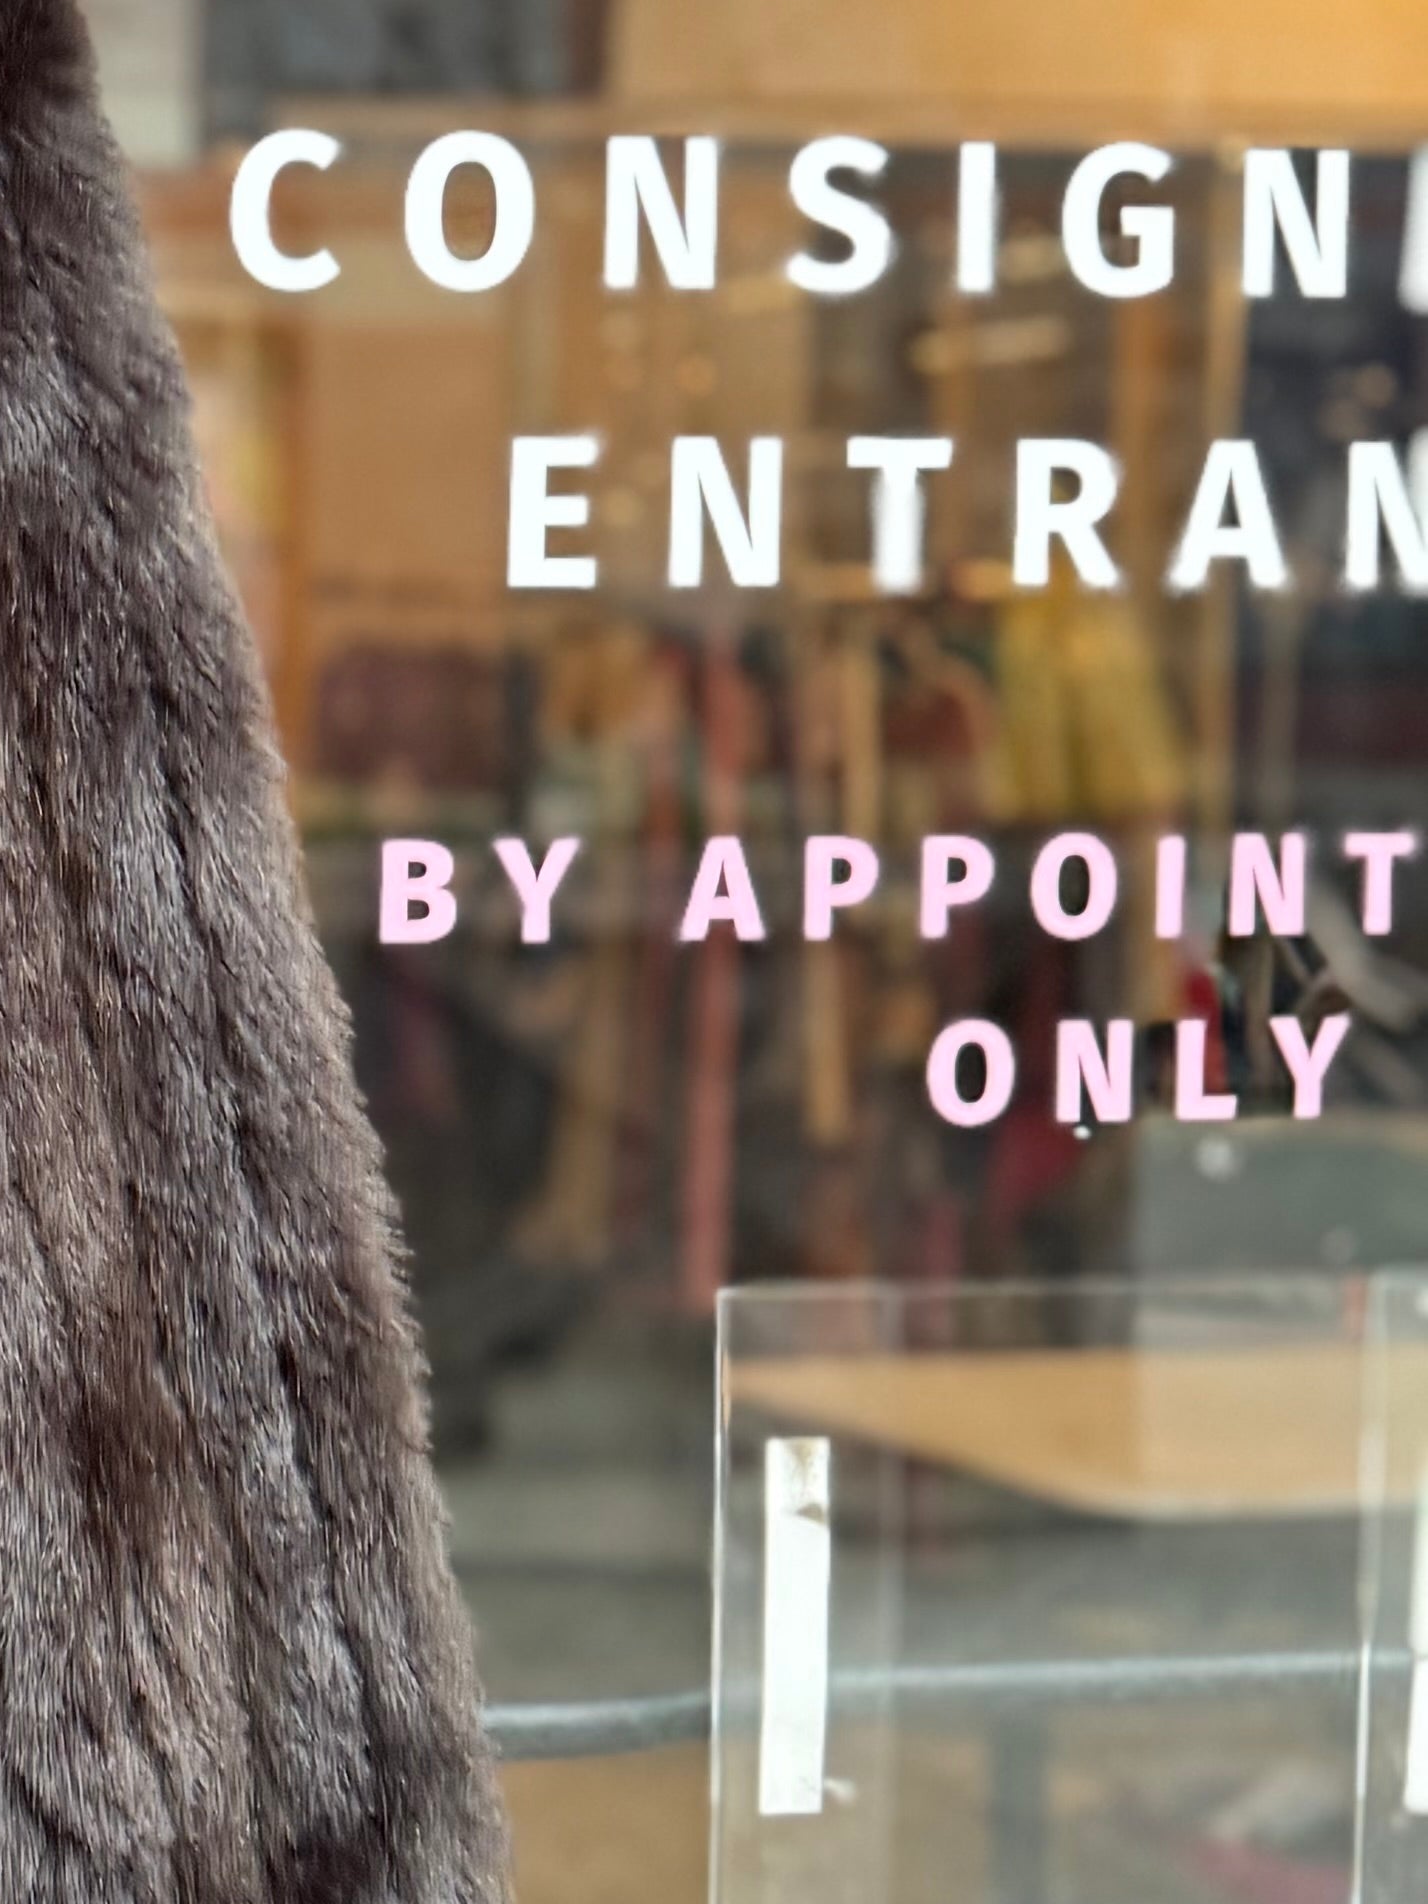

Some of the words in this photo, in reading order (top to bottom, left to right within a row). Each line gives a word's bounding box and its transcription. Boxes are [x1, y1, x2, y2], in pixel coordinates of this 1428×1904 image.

[505, 435, 1428, 590] ENTRAN
[377, 837, 580, 945] BY
[678, 830, 1415, 942] APPOINT
[925, 1015, 1350, 1128] ONLY
